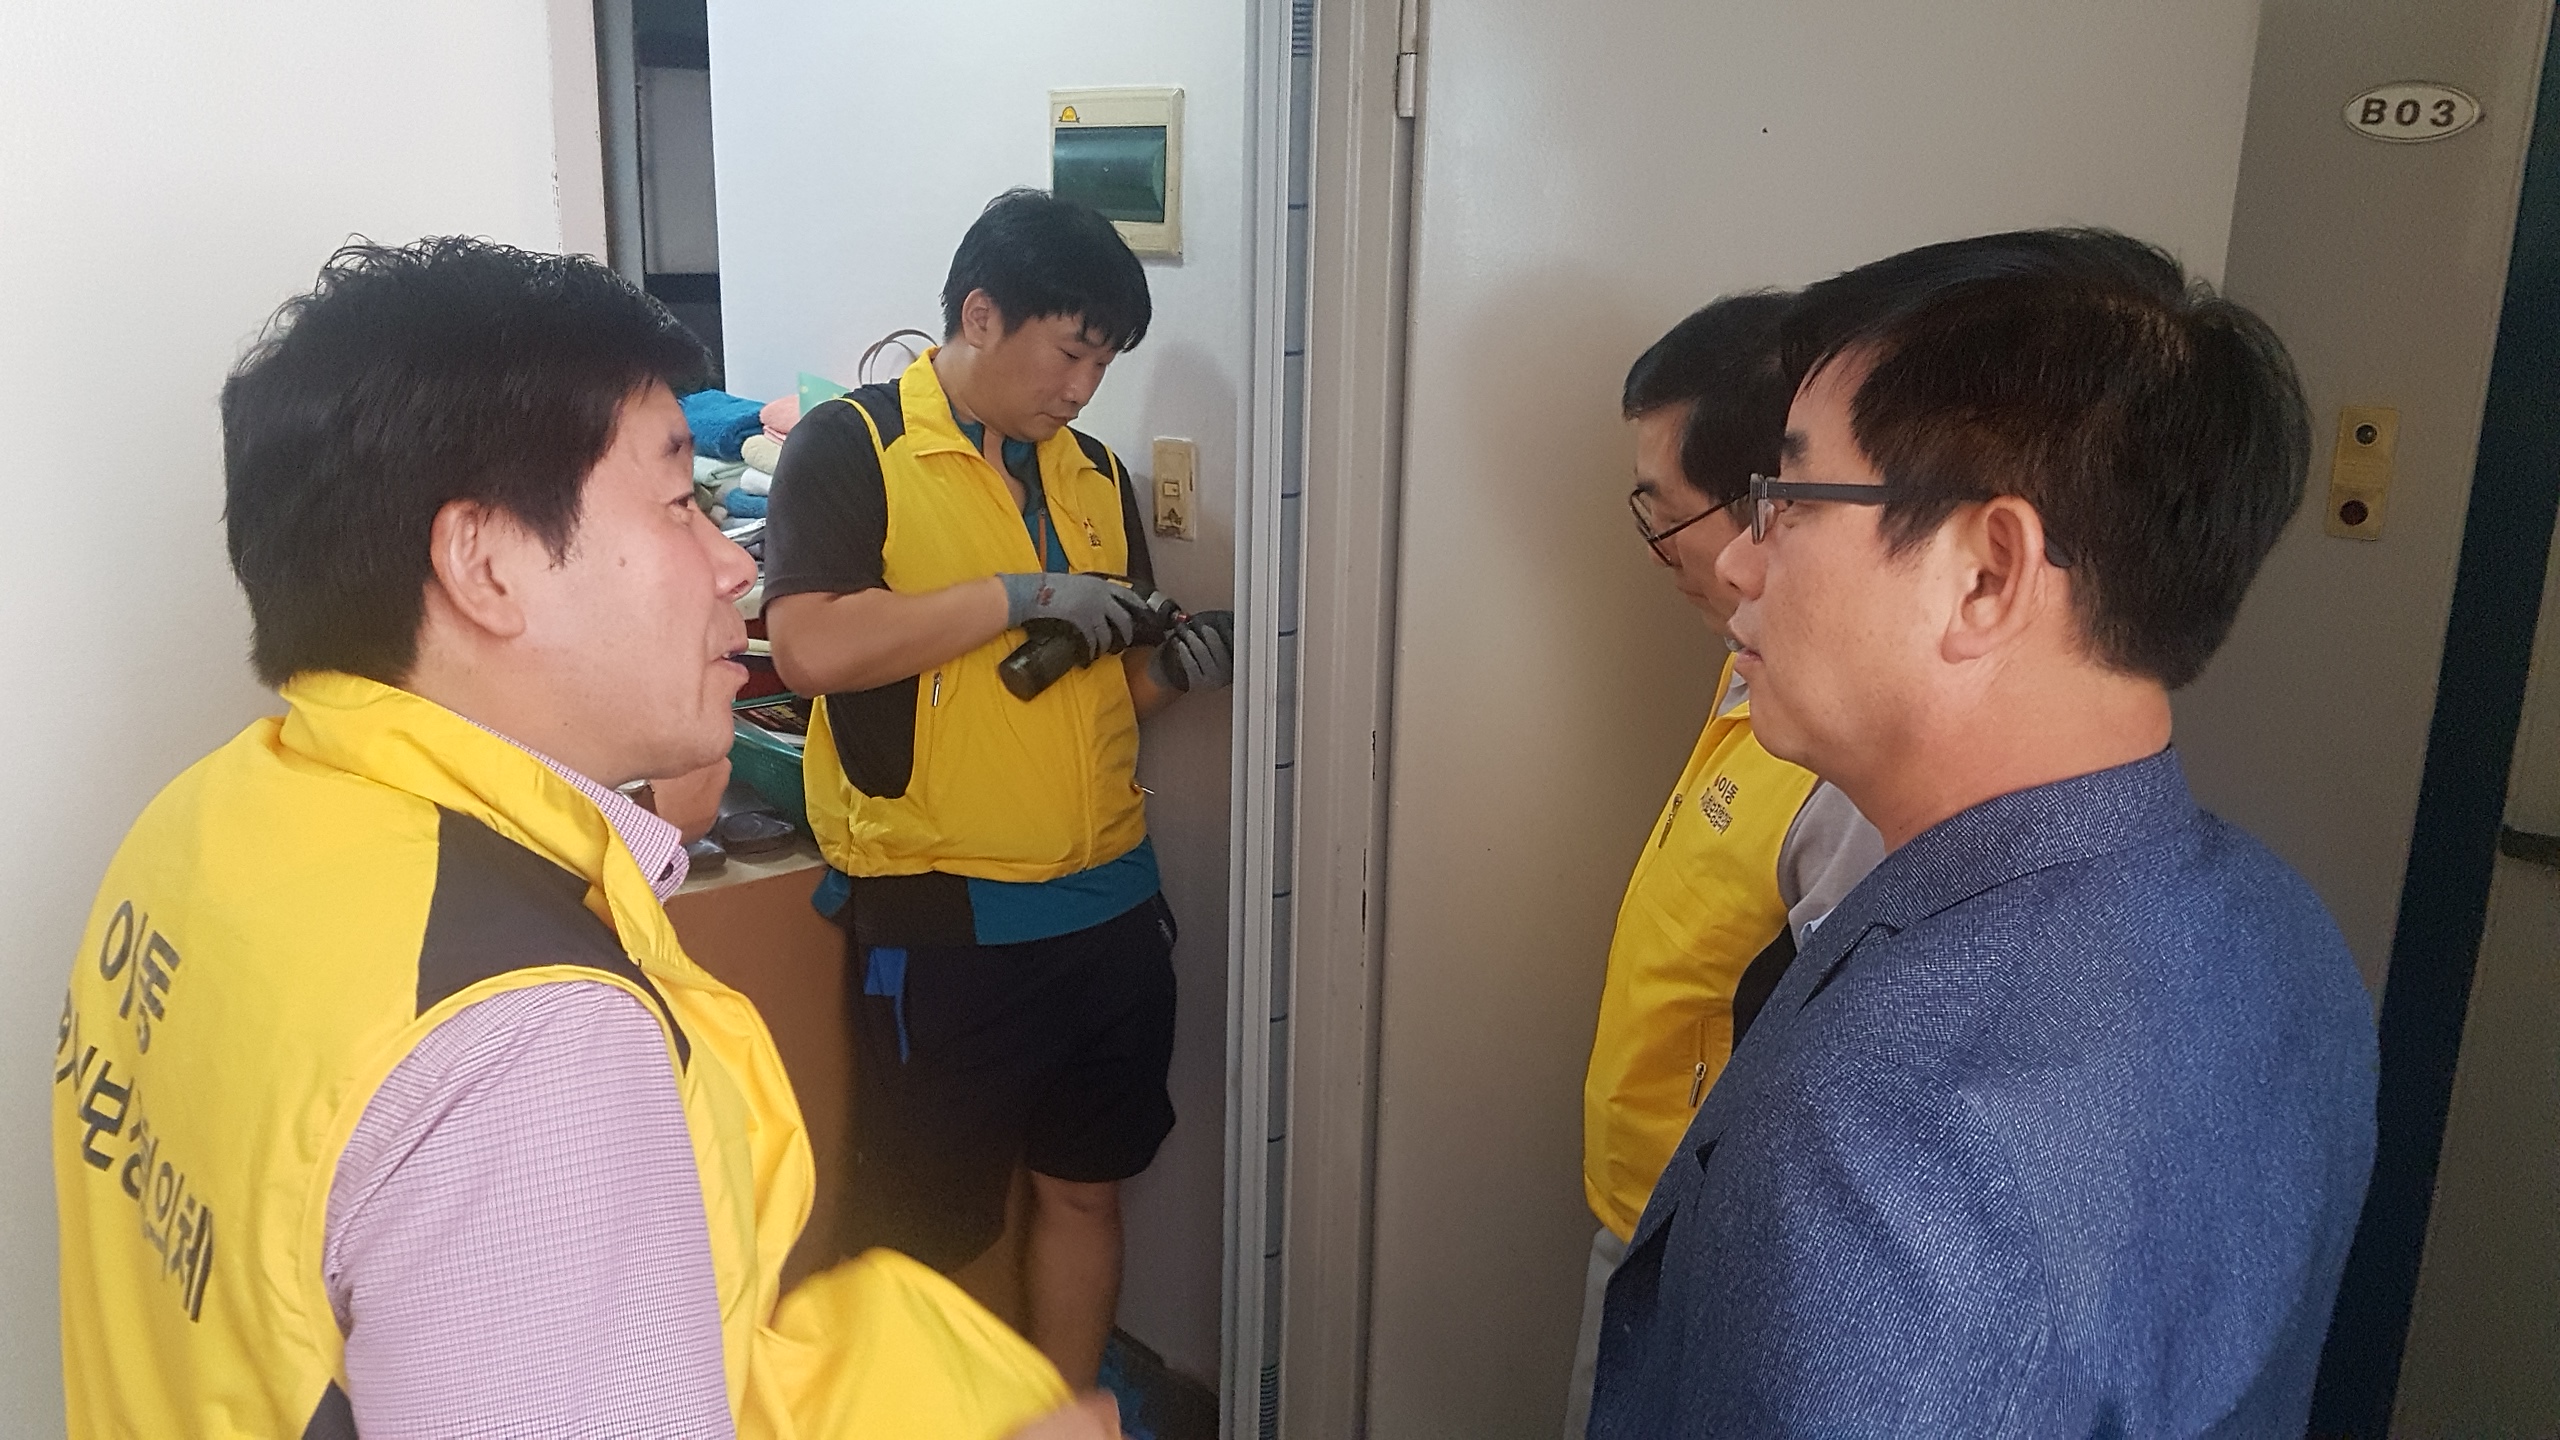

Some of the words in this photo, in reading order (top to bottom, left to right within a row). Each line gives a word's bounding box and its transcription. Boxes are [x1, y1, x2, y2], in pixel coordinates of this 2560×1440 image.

[2360, 98, 2456, 127] B03
[1718, 776, 1739, 805] 이동
[100, 900, 180, 1054] 이동
